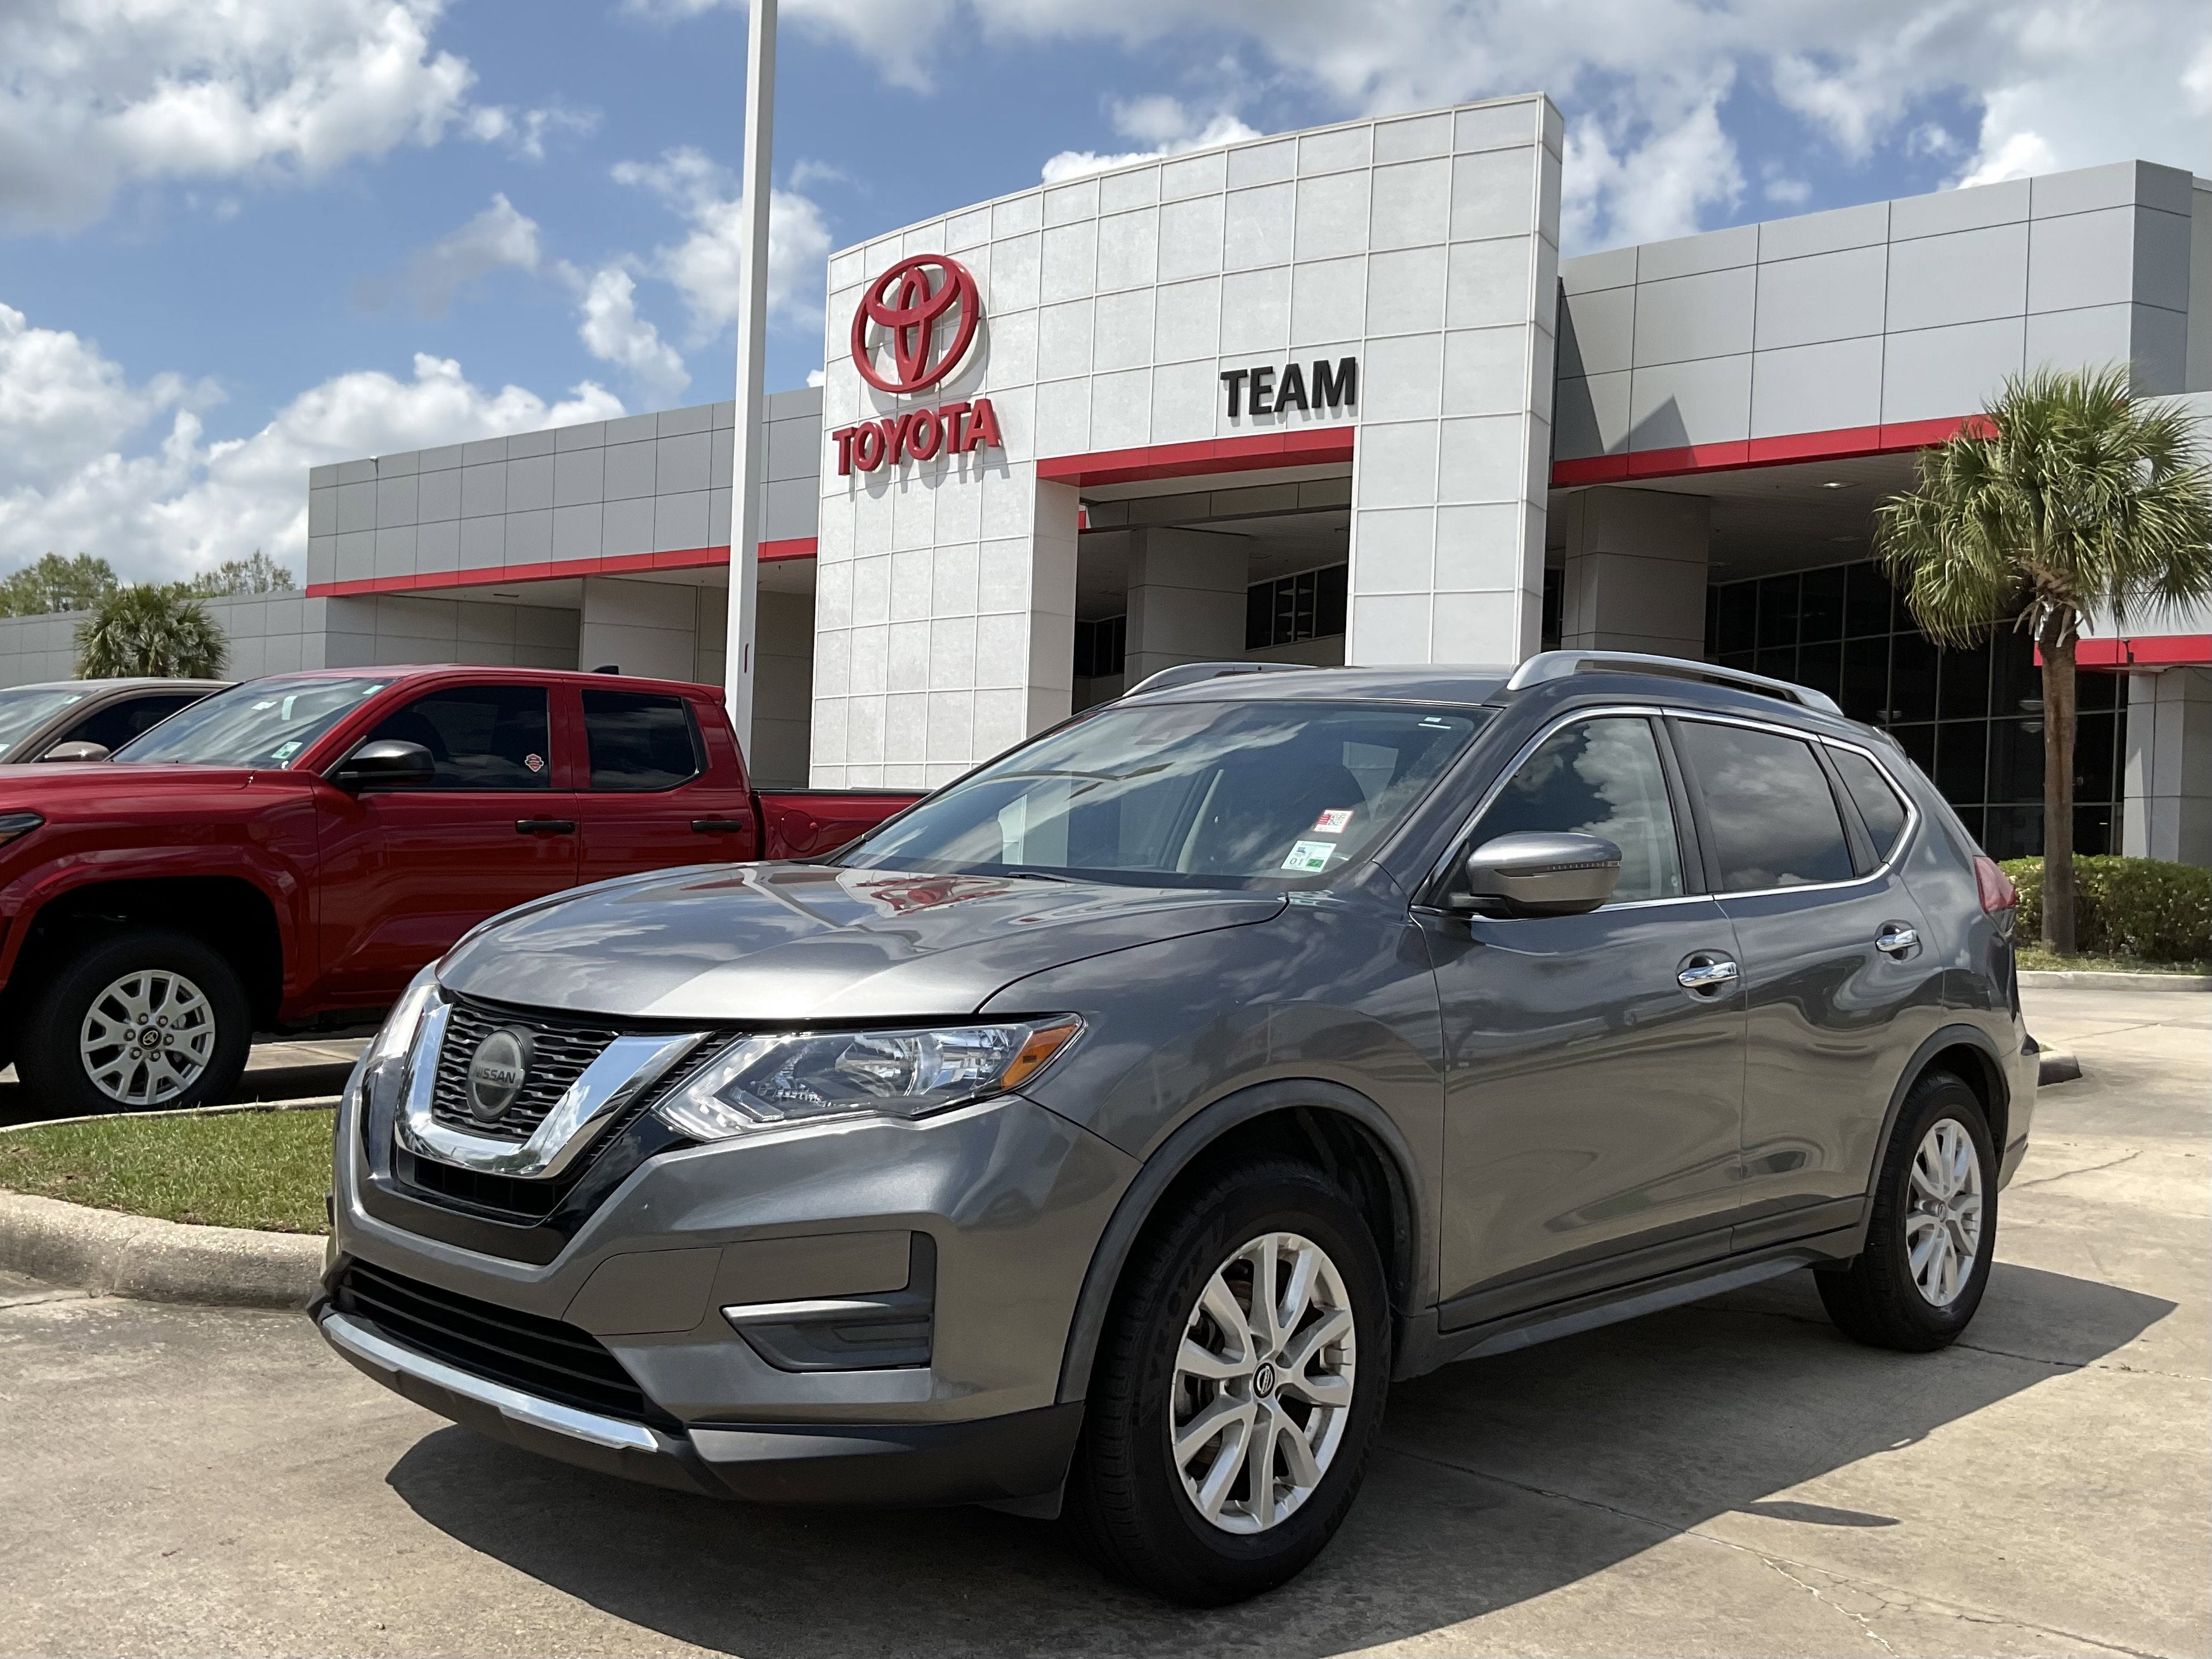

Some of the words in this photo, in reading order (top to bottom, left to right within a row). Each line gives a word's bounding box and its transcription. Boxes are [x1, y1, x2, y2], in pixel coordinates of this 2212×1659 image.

[1220, 356, 1357, 418] TEAM
[832, 398, 1001, 476] TOYOTA
[475, 1066, 516, 1084] NISSAN
